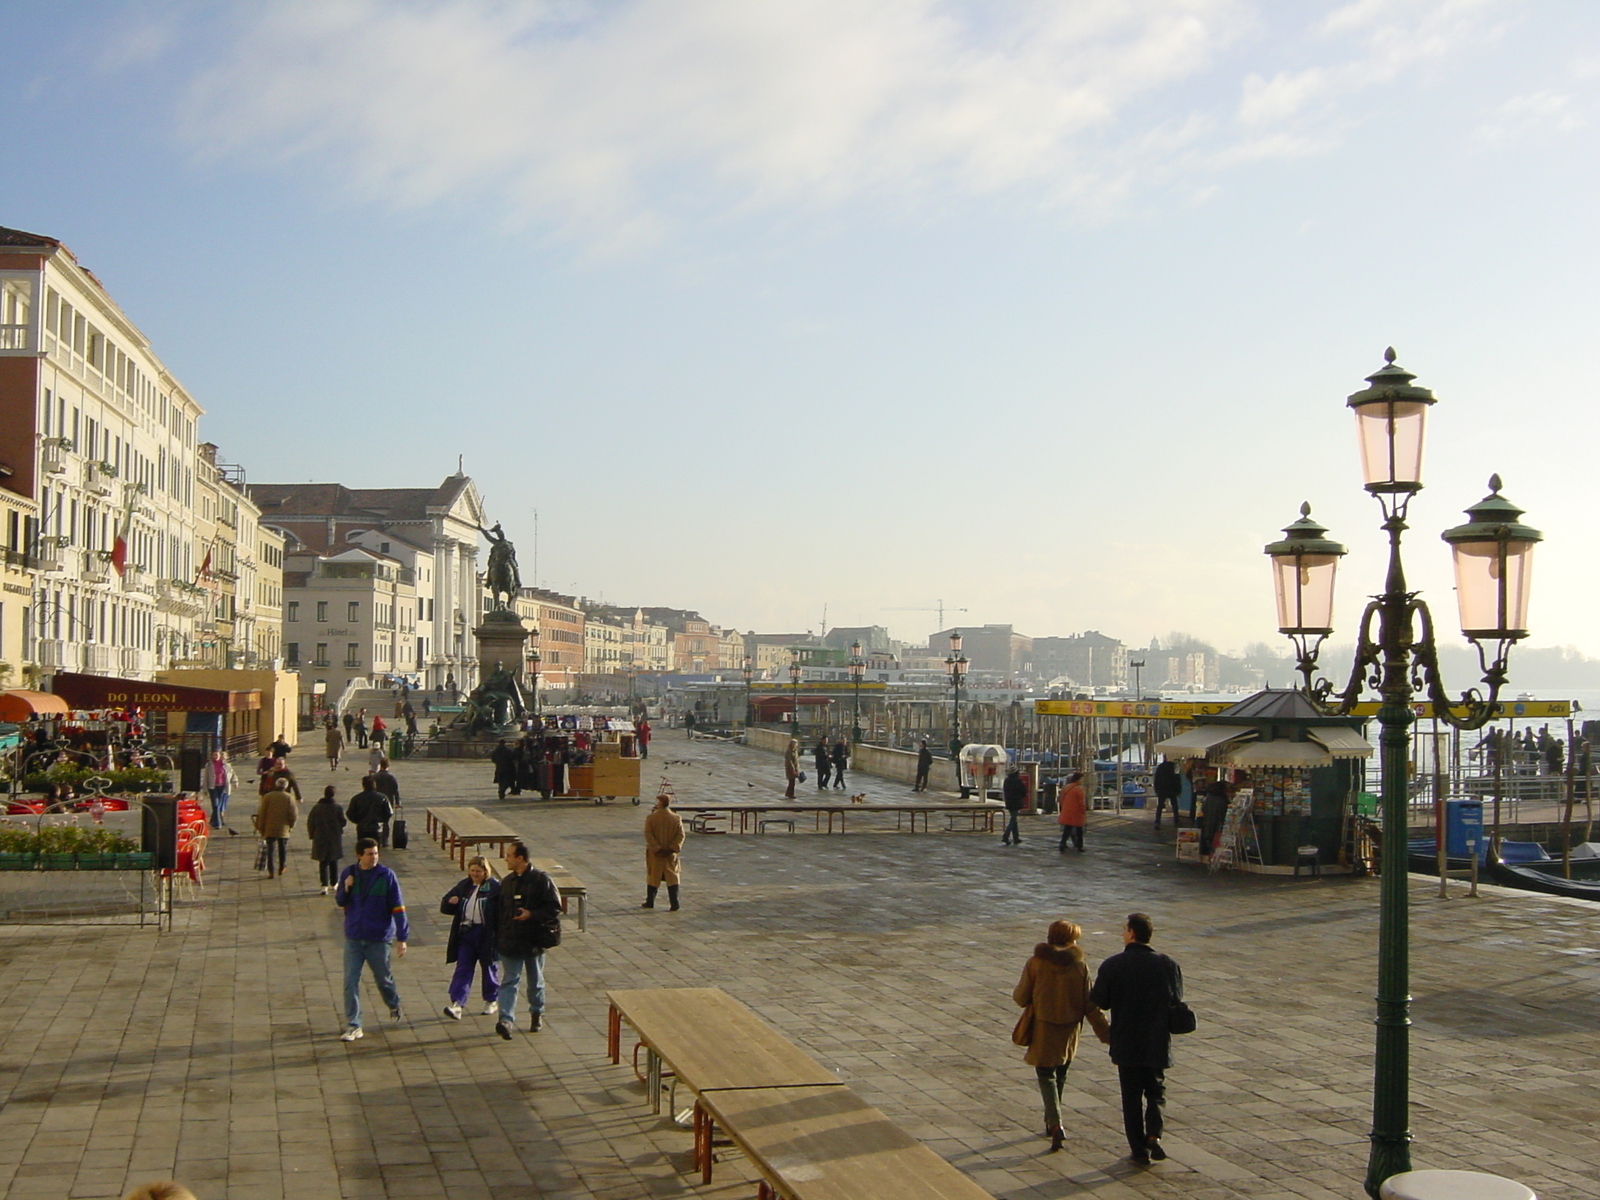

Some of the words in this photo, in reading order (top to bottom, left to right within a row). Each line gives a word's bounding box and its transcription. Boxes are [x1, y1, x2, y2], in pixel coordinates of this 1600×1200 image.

[108, 693, 128, 702] DO
[134, 693, 176, 703] LEONI
[1415, 706, 1424, 714] 42
[1547, 704, 1566, 713] Actv
